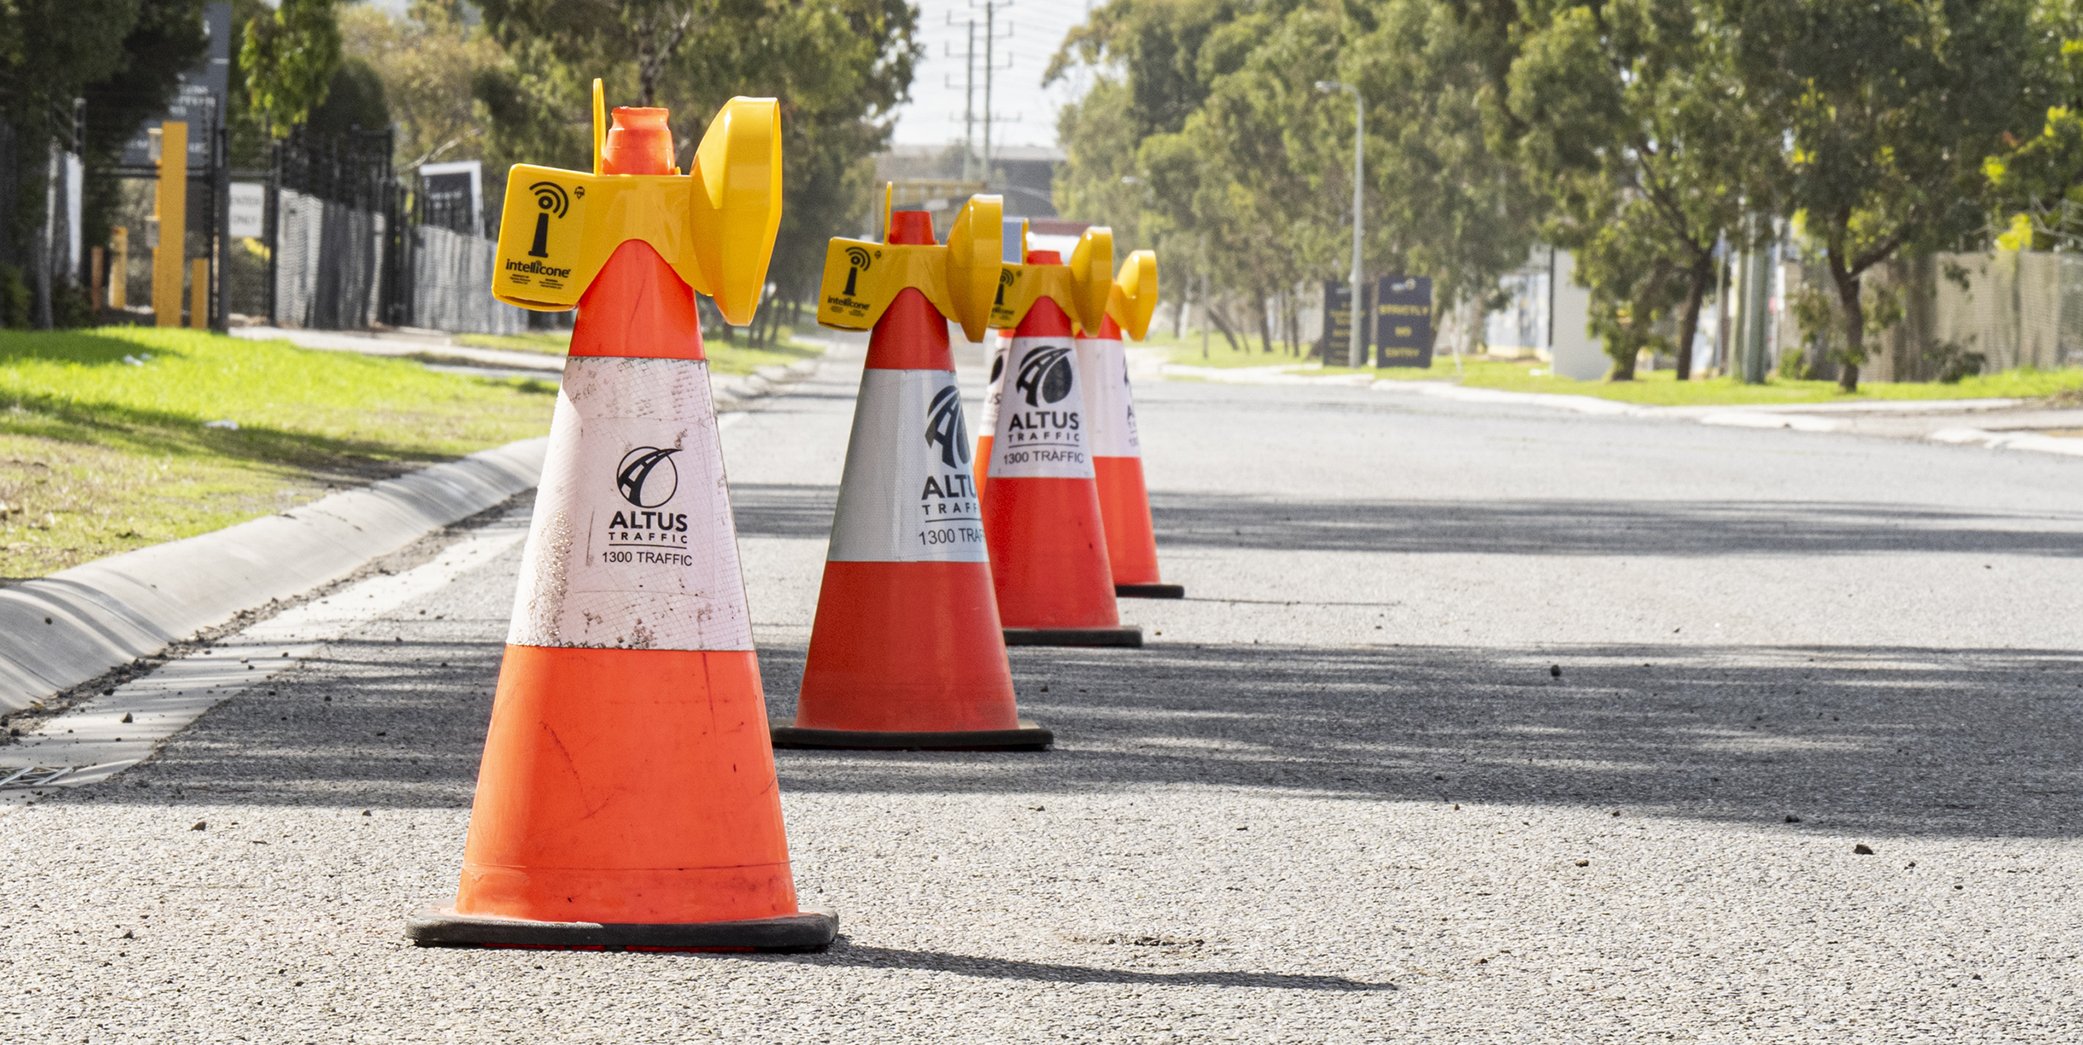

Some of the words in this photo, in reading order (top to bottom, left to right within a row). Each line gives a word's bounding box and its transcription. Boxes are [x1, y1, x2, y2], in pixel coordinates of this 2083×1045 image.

[505, 259, 571, 278] intellicone
[1008, 411, 1080, 432] ALTUS
[1008, 431, 1080, 443] TRAFFIC
[1003, 451, 1030, 465] 1300
[1032, 450, 1085, 464] TRAFFIC
[609, 510, 688, 532] ALTUS
[609, 532, 688, 544] TRAFFIC
[918, 528, 956, 545] 1300
[602, 551, 633, 563] 1300
[636, 551, 693, 567] TRAFFIC
